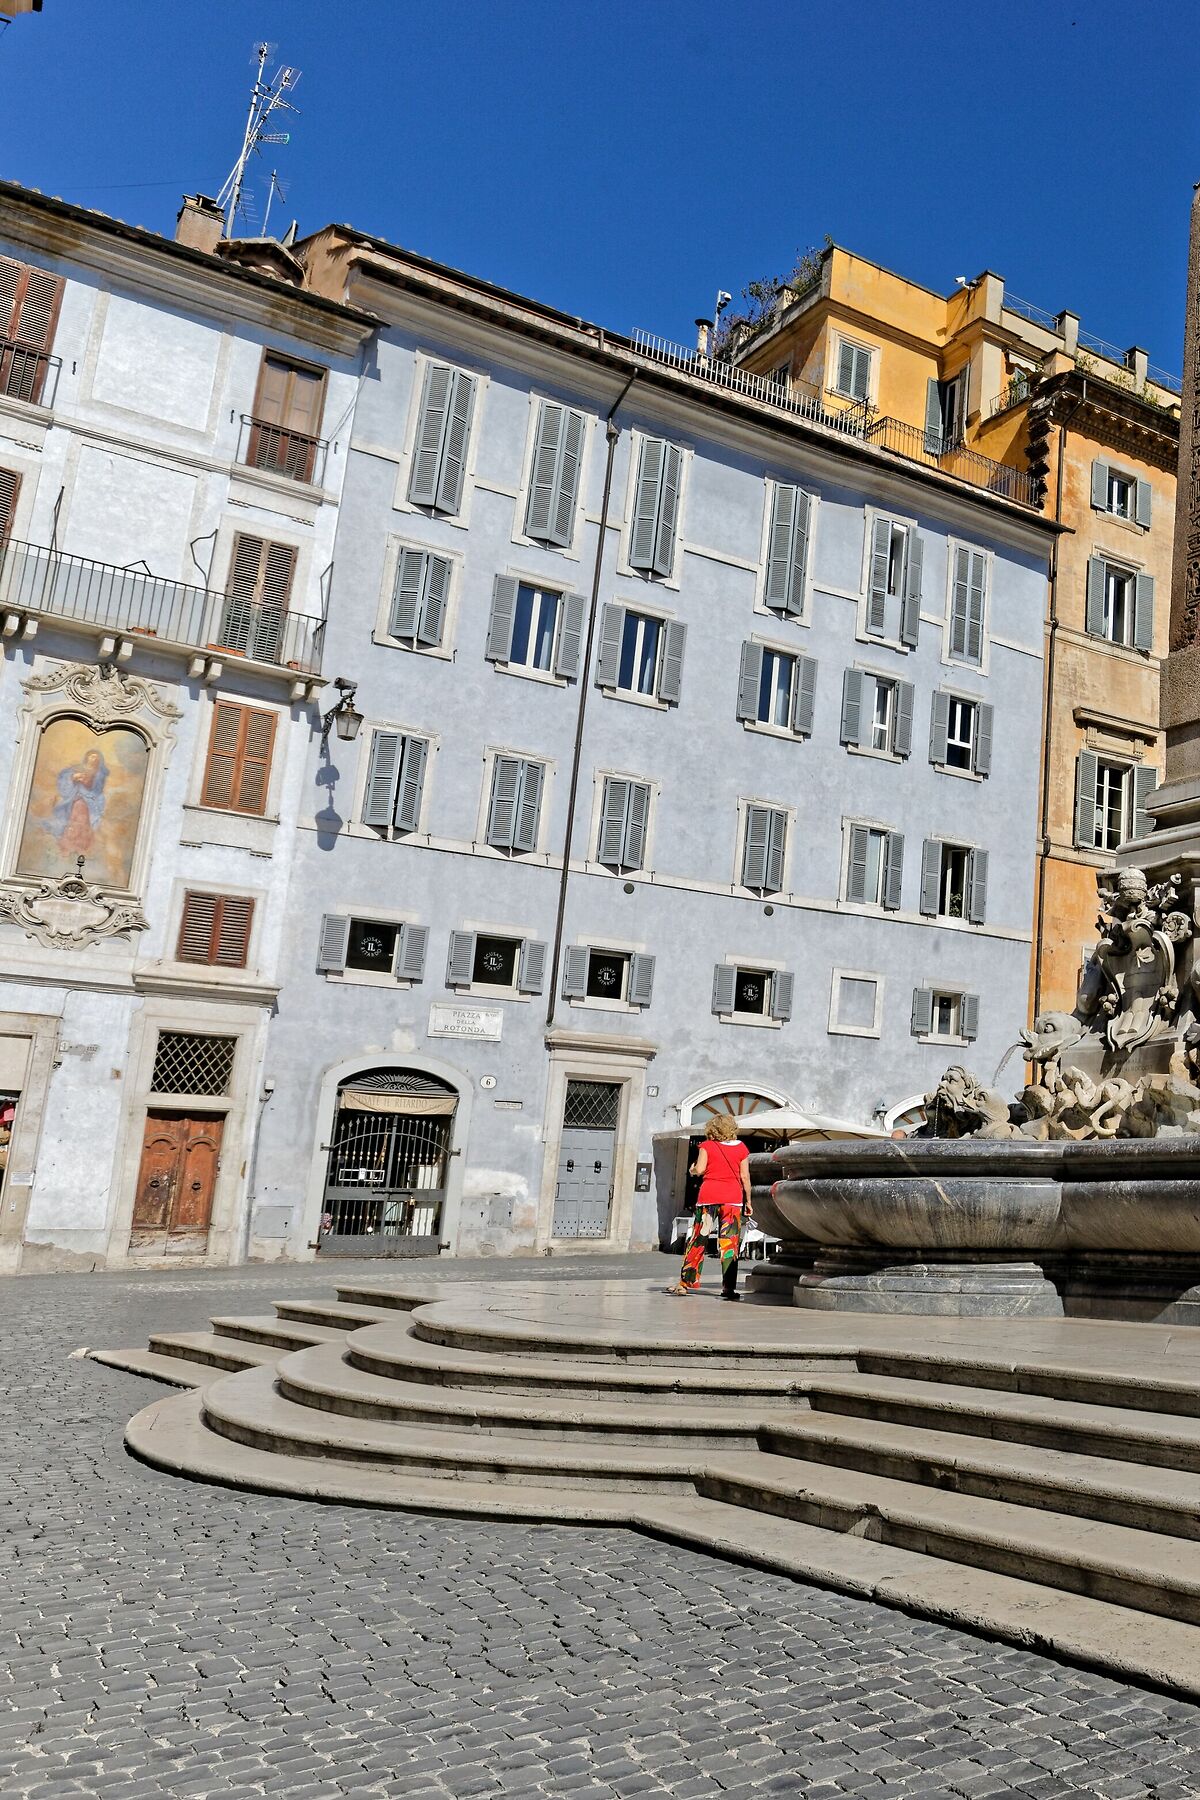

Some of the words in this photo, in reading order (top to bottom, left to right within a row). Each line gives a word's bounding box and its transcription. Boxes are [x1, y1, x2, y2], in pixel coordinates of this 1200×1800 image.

[367, 943, 376, 952] IL
[490, 957, 497, 966] IL
[452, 1011, 481, 1019] PIAZZA
[443, 1025, 486, 1033] ROTONDA
[485, 1078, 491, 1086] 6
[394, 1097, 428, 1109] RITARDO
